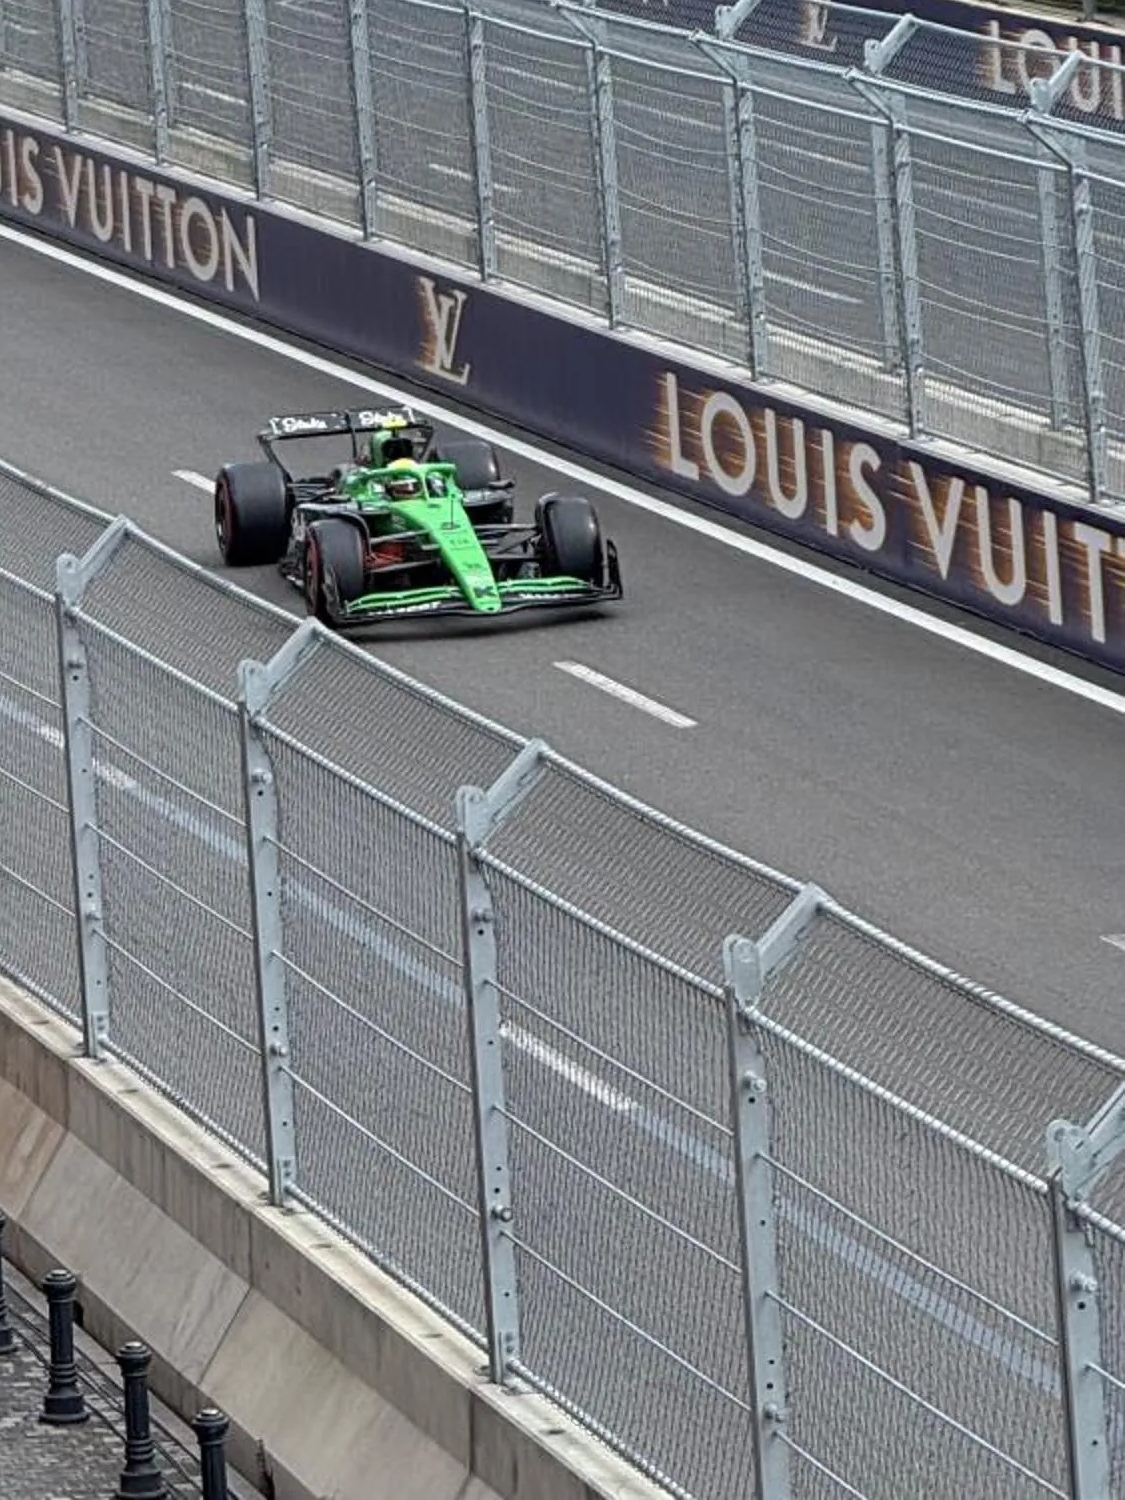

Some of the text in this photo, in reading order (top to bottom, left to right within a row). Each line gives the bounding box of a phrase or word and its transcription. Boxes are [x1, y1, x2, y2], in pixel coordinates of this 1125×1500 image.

[55, 145, 260, 302] VUITTON
[665, 372, 1125, 644] LOUIS VUIT
